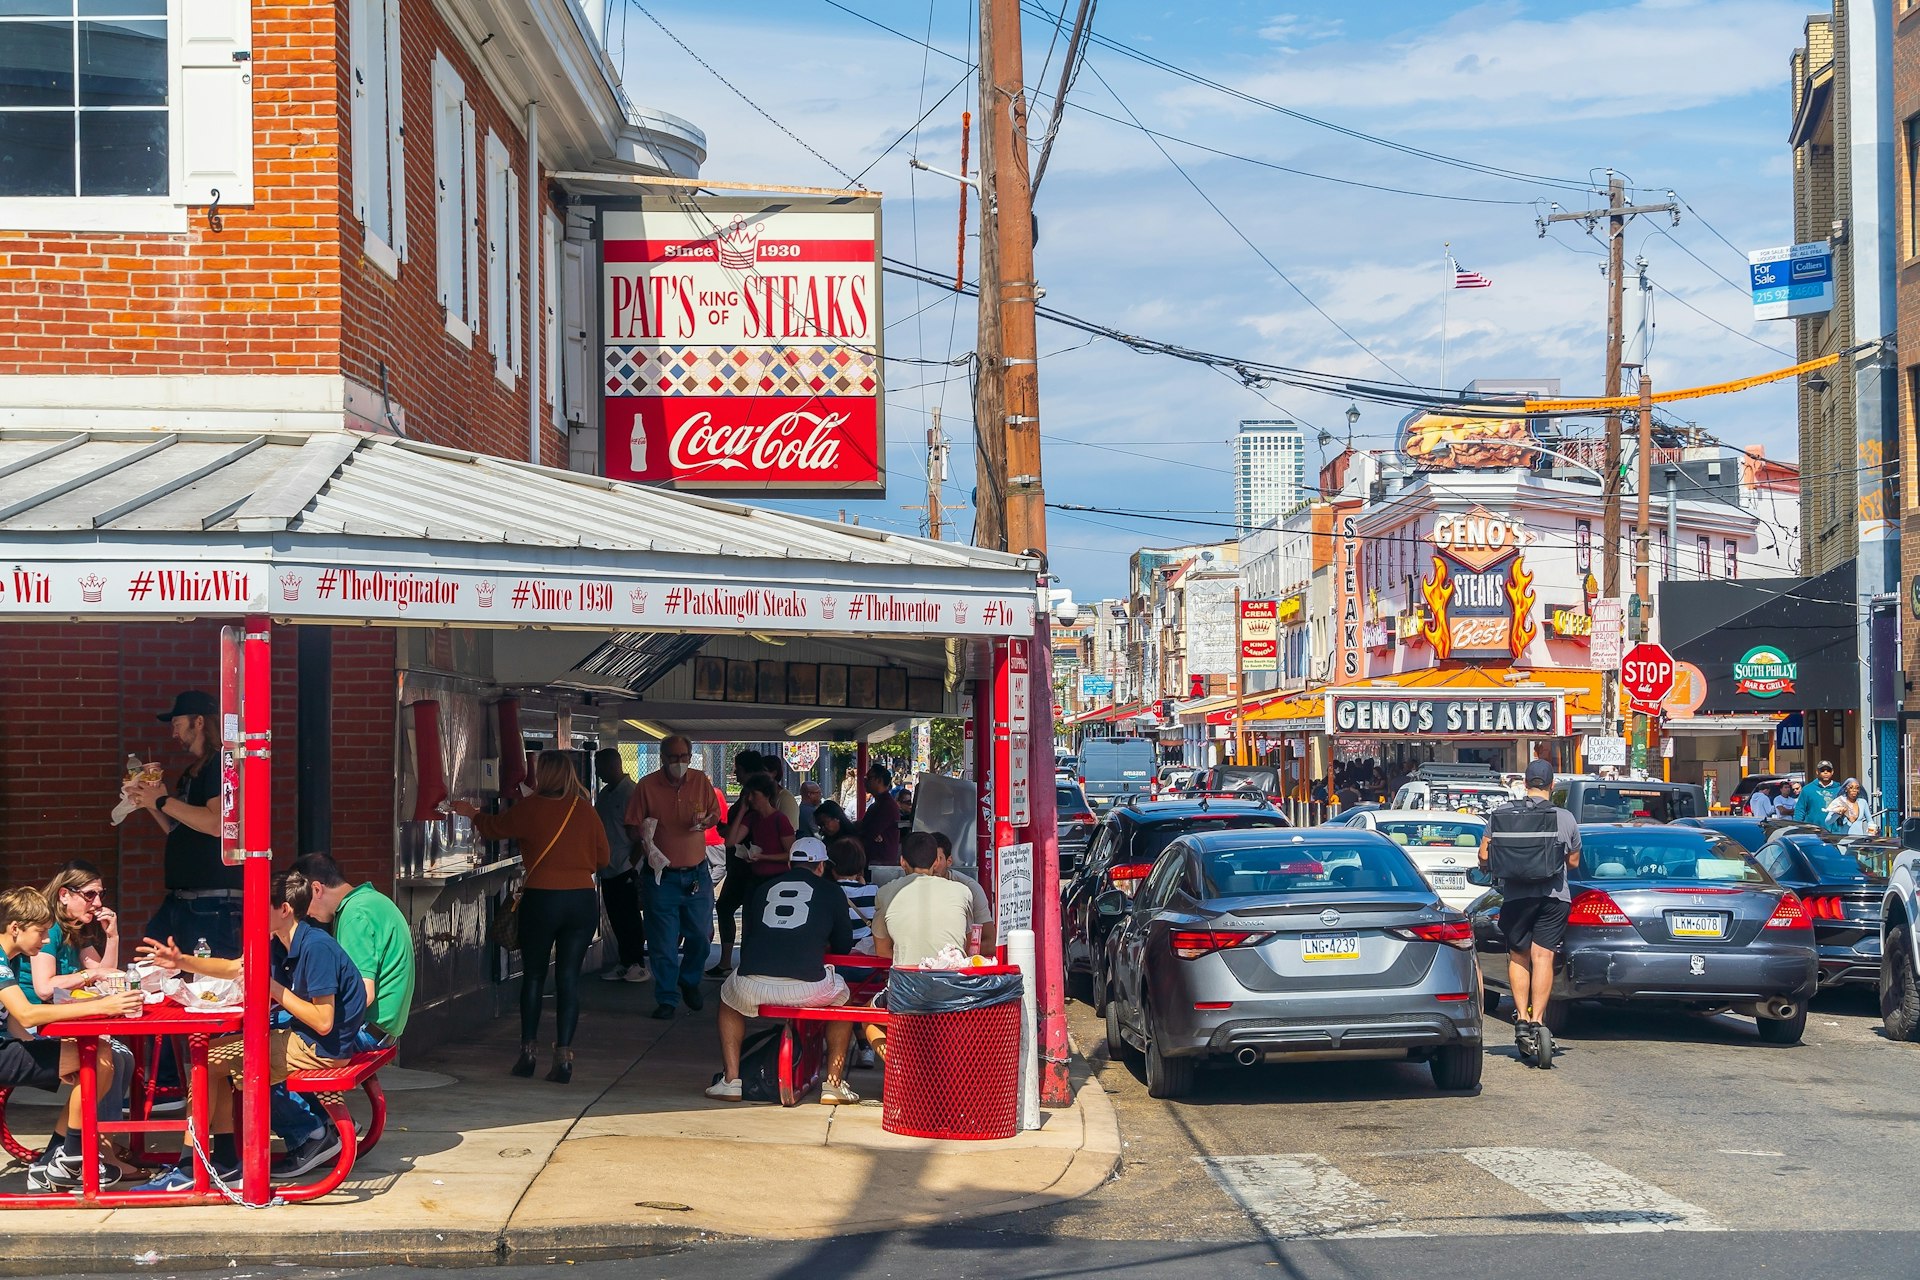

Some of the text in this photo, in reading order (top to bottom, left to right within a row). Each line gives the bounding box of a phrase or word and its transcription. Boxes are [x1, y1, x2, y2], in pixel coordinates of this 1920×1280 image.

[664, 244, 801, 257] Since 1930
[1754, 264, 1771, 274] For
[1754, 274, 1776, 285] Sale
[1796, 262, 1823, 271] Colliers
[610, 275, 869, 338] PAT'S KING OF STEAKS
[1756, 291, 1773, 303] 215
[668, 410, 852, 471] Coca-Cola
[1433, 514, 1526, 550] GENO'S
[12, 570, 52, 604] Wit
[128, 569, 251, 602] #WhizWit
[316, 568, 460, 610] #TheOriginator
[511, 580, 613, 613] #Since 1930
[1342, 515, 1359, 676] STEAKS
[1453, 573, 1504, 608] STEAKS
[848, 594, 941, 623] #TheInventor
[983, 600, 1013, 626] #Yo
[1244, 610, 1273, 618] CREMA
[1451, 618, 1508, 649] Best
[1243, 645, 1275, 656] CANNOLI
[1624, 660, 1671, 684] STOP
[1735, 662, 1797, 679] SOUTH PHILLY
[1744, 681, 1758, 689] BAR
[1766, 681, 1787, 690] GRILL
[1336, 701, 1434, 732] GENO'S
[1447, 701, 1553, 732] STEAKS
[1001, 866, 1031, 883] George Smith
[761, 880, 814, 929] 8
